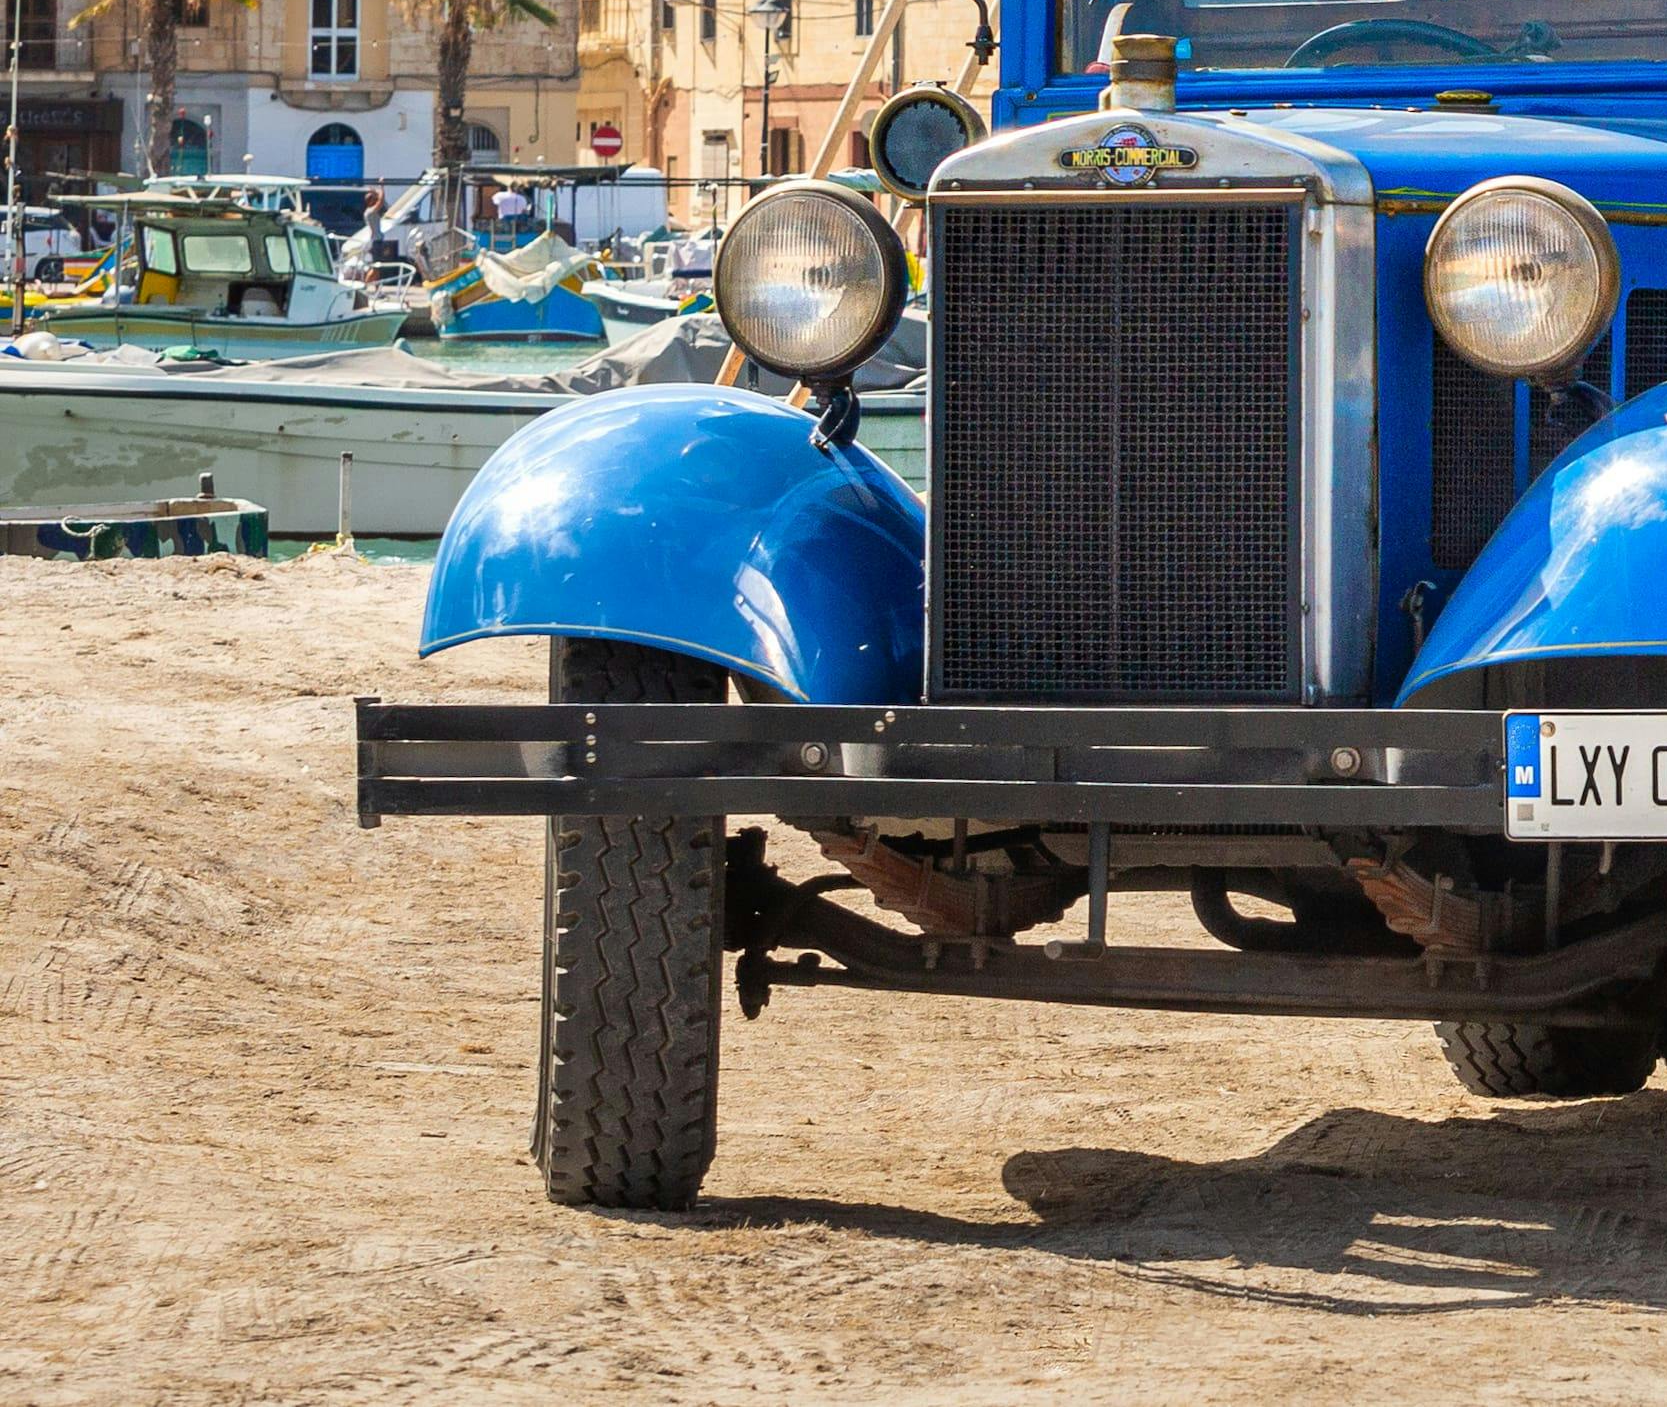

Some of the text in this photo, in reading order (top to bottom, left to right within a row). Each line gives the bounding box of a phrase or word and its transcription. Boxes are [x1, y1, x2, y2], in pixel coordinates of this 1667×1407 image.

[1072, 147, 1184, 167] MORRIS-COMMERCIAL
[1515, 765, 1535, 785] M
[1550, 745, 1631, 807] LXY
